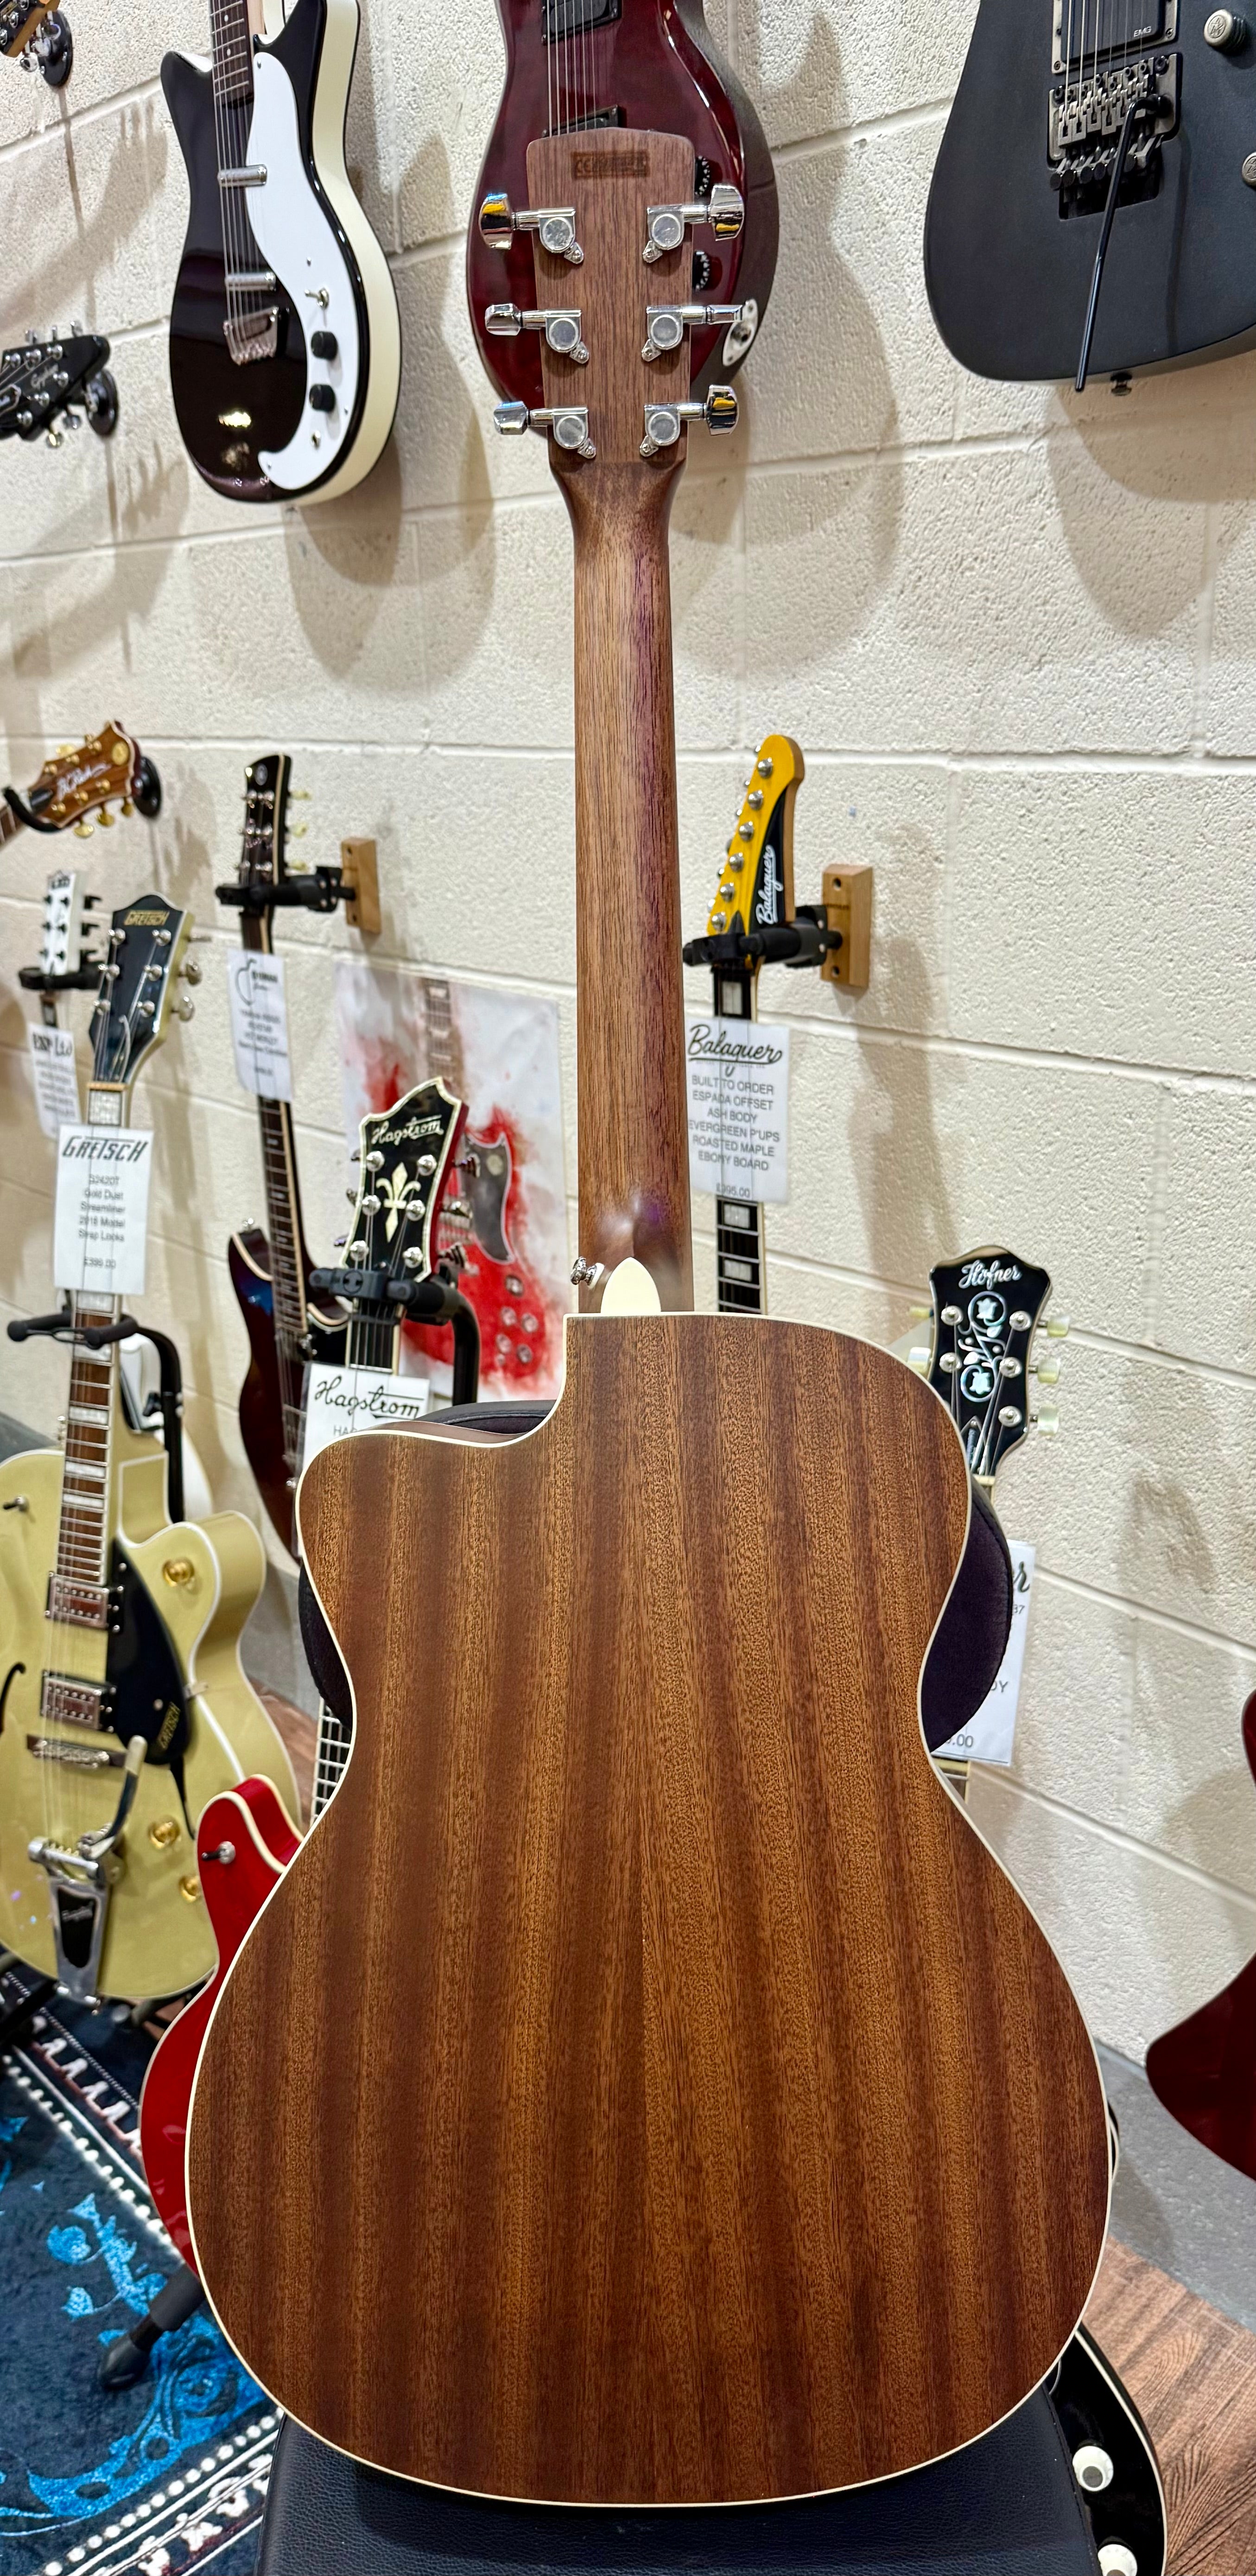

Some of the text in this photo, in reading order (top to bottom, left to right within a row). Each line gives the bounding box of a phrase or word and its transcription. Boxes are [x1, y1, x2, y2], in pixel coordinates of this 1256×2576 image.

[1133, 26, 1151, 37] EMG
[755, 844, 784, 924] Balaguer
[123, 910, 170, 926] GRETSCH
[688, 1024, 783, 1078] Balaguer
[691, 1075, 774, 1095] BUILT TO ORDER
[692, 1090, 774, 1111] ESPADA OFFSET
[707, 1108, 757, 1124] ASH BODY
[371, 1114, 444, 1146] Hagstrom
[689, 1120, 780, 1143] EVERGREEN P'UPS
[62, 1136, 149, 1162] GRETSCH
[692, 1135, 775, 1157] ROASTED MAPLE
[698, 1151, 769, 1171] EBONY BOARD
[84, 1187, 124, 1200] Gold Dust
[81, 1201, 125, 1213] Streamliner
[101, 1216, 126, 1228] Model
[101, 1231, 124, 1242] Locks
[315, 1374, 425, 1420] Hagstrom
